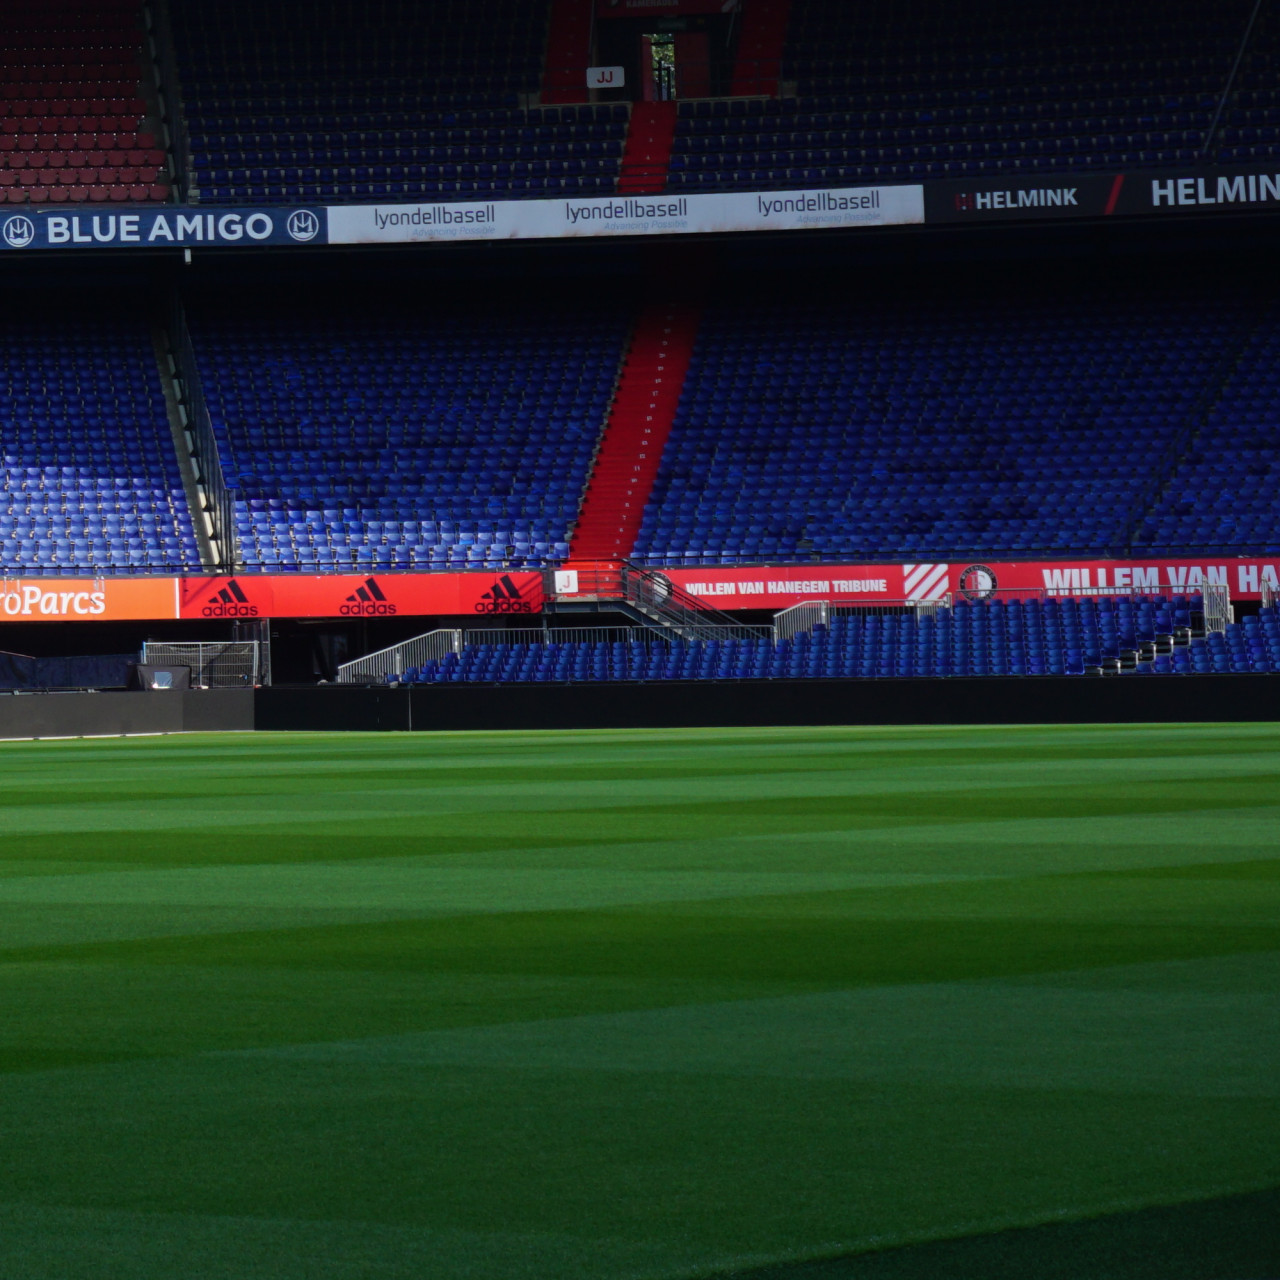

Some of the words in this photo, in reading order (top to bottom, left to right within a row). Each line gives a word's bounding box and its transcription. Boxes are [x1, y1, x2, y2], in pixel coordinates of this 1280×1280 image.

[597, 72, 613, 83] JJ
[976, 188, 1078, 210] HELMINK
[1151, 174, 1280, 207] HELMIN
[566, 198, 687, 223] lyondellbasell
[758, 190, 880, 215] lyondellbasell
[374, 204, 495, 229] lyondellbasell
[604, 220, 647, 231] Advancing
[649, 219, 688, 229] Possible
[841, 212, 880, 222] Possible
[48, 216, 139, 243] BLUE
[148, 214, 273, 242] AMIGO
[412, 227, 455, 238] Advancing
[457, 225, 495, 236] Possible
[563, 574, 571, 590] J
[686, 582, 736, 596] WILLEM
[738, 581, 765, 595] VAN
[768, 579, 830, 595] HANEGEM
[832, 578, 887, 593] TRIBUNE
[1043, 567, 1159, 597] WILLEM
[1167, 565, 1229, 593] VAN
[202, 603, 258, 617] adidas
[340, 601, 396, 615] adidas
[474, 599, 531, 614] adidas
